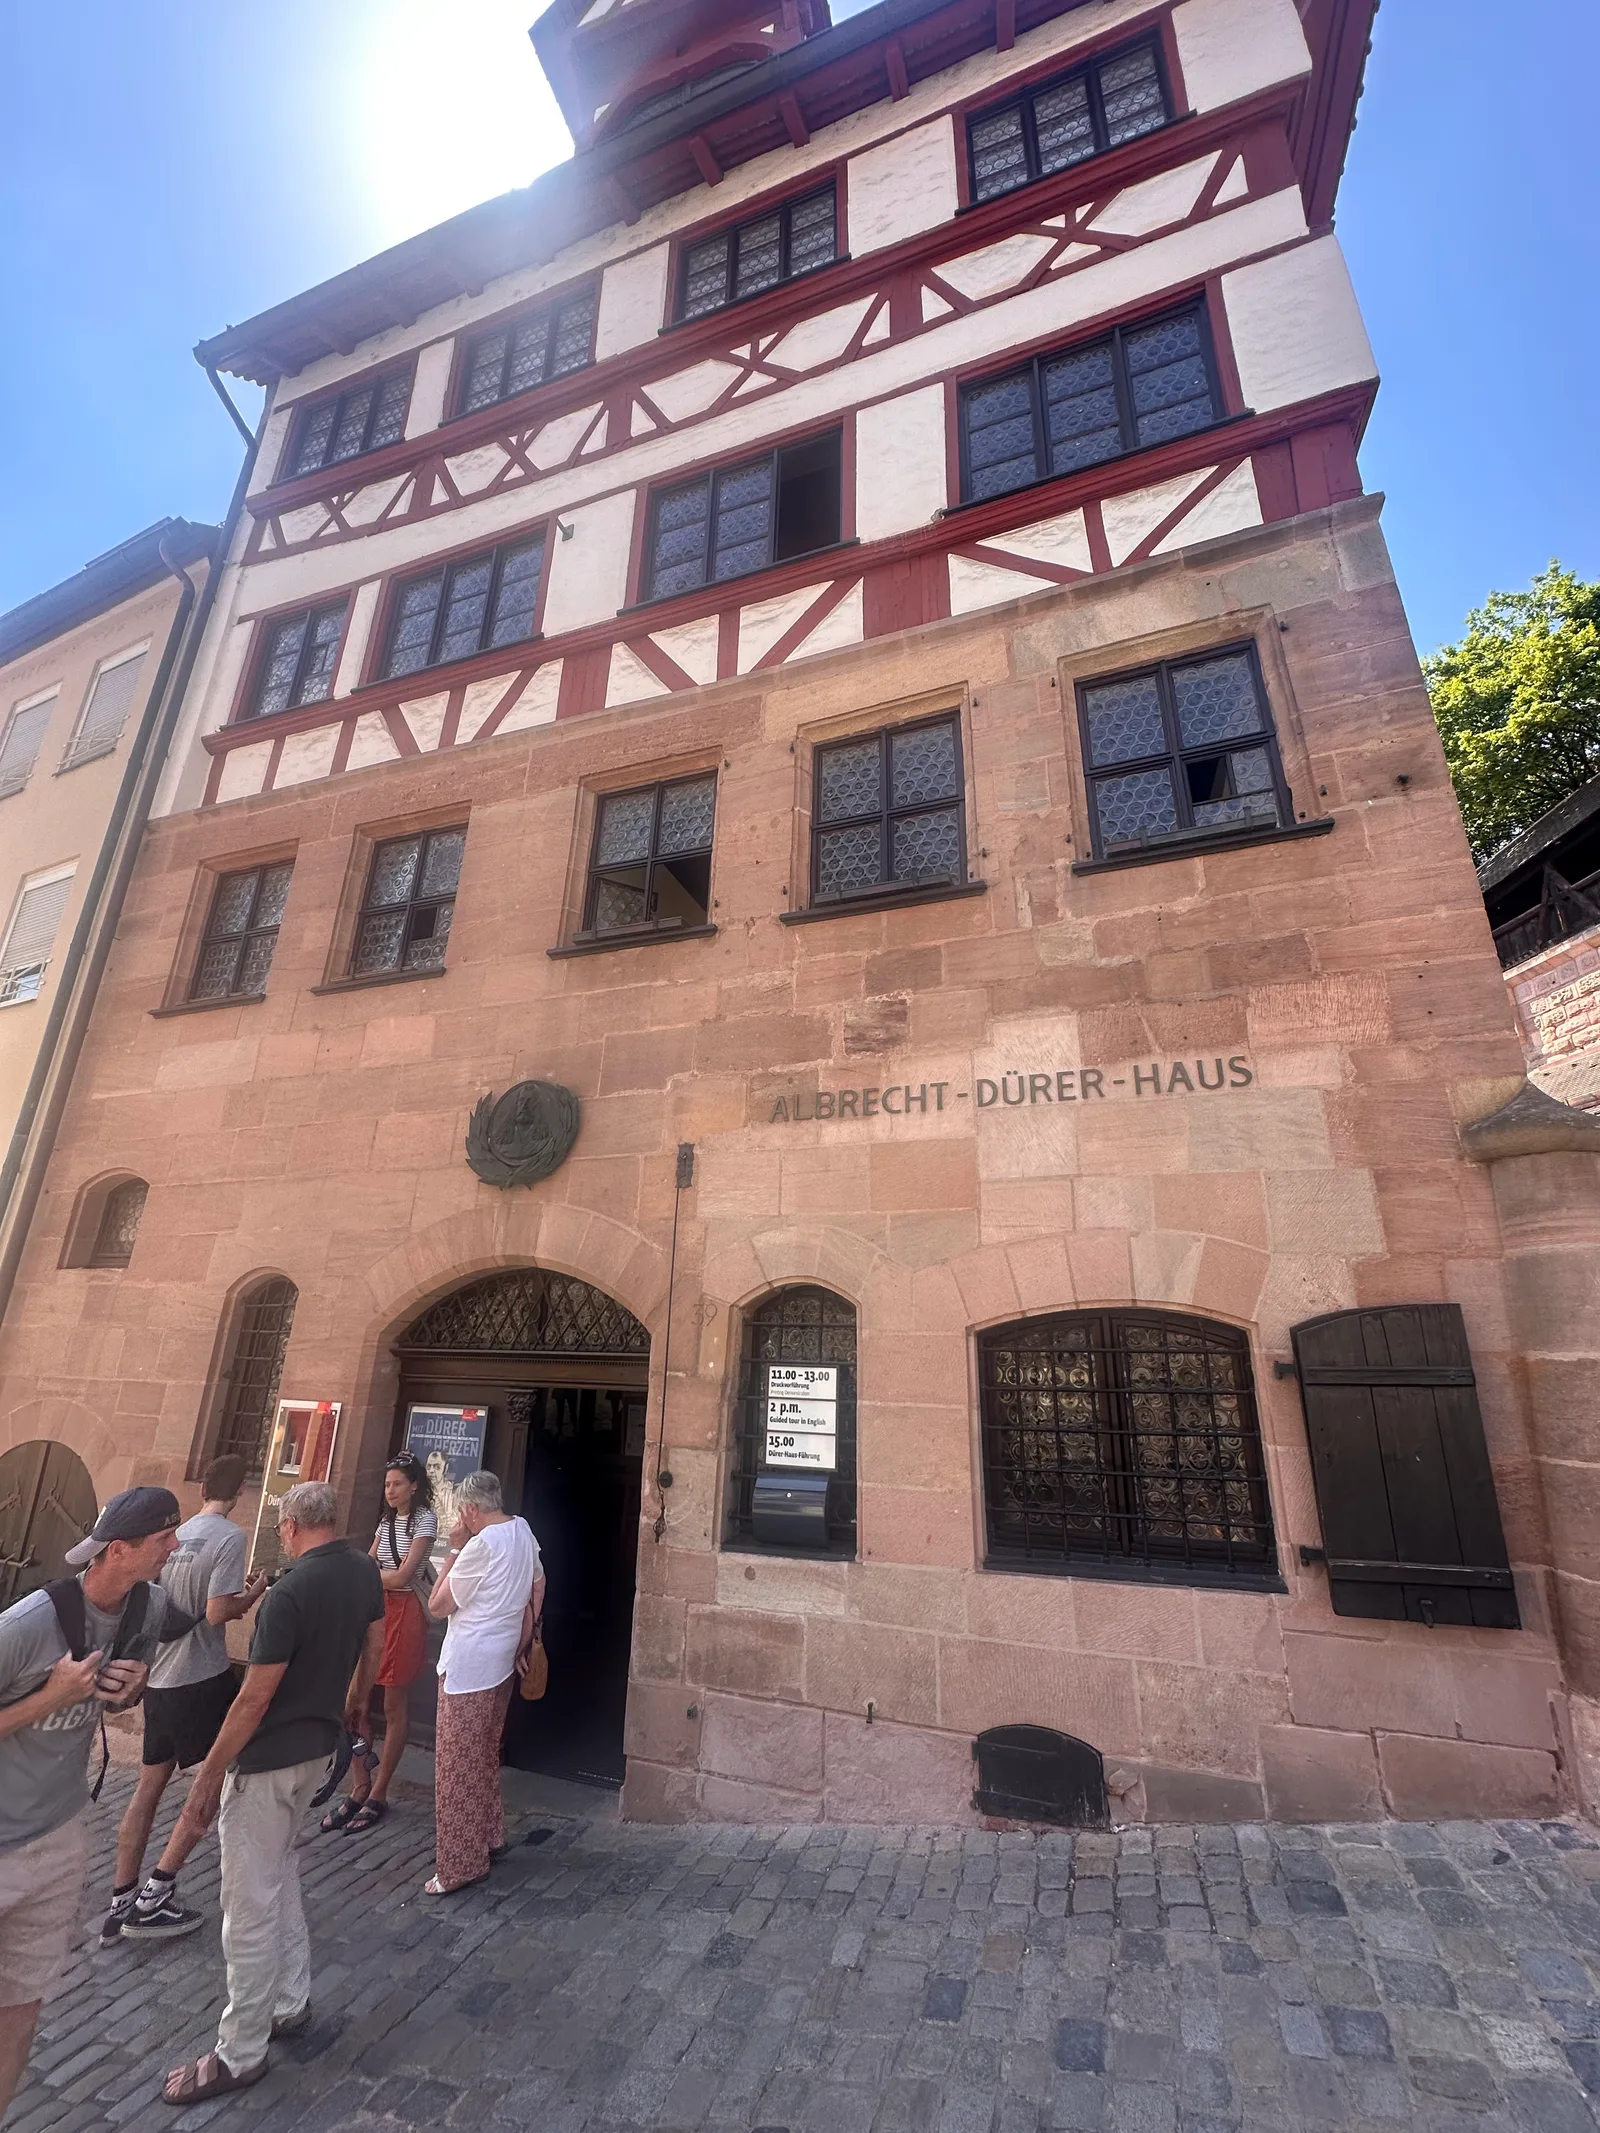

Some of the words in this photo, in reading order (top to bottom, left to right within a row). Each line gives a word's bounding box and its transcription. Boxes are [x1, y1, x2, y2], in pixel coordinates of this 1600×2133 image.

[769, 1055, 1253, 1123] ALBRECHT-DÜRER-HAUS
[771, 1370, 796, 1379] 11.00
[804, 1371, 829, 1382] 13.00
[770, 1402, 776, 1412] 2
[780, 1403, 801, 1415] p.m.
[426, 1416, 466, 1436] DÜRER
[807, 1418, 826, 1427] English
[434, 1439, 479, 1457] HERZEN
[769, 1436, 794, 1447] 15.00
